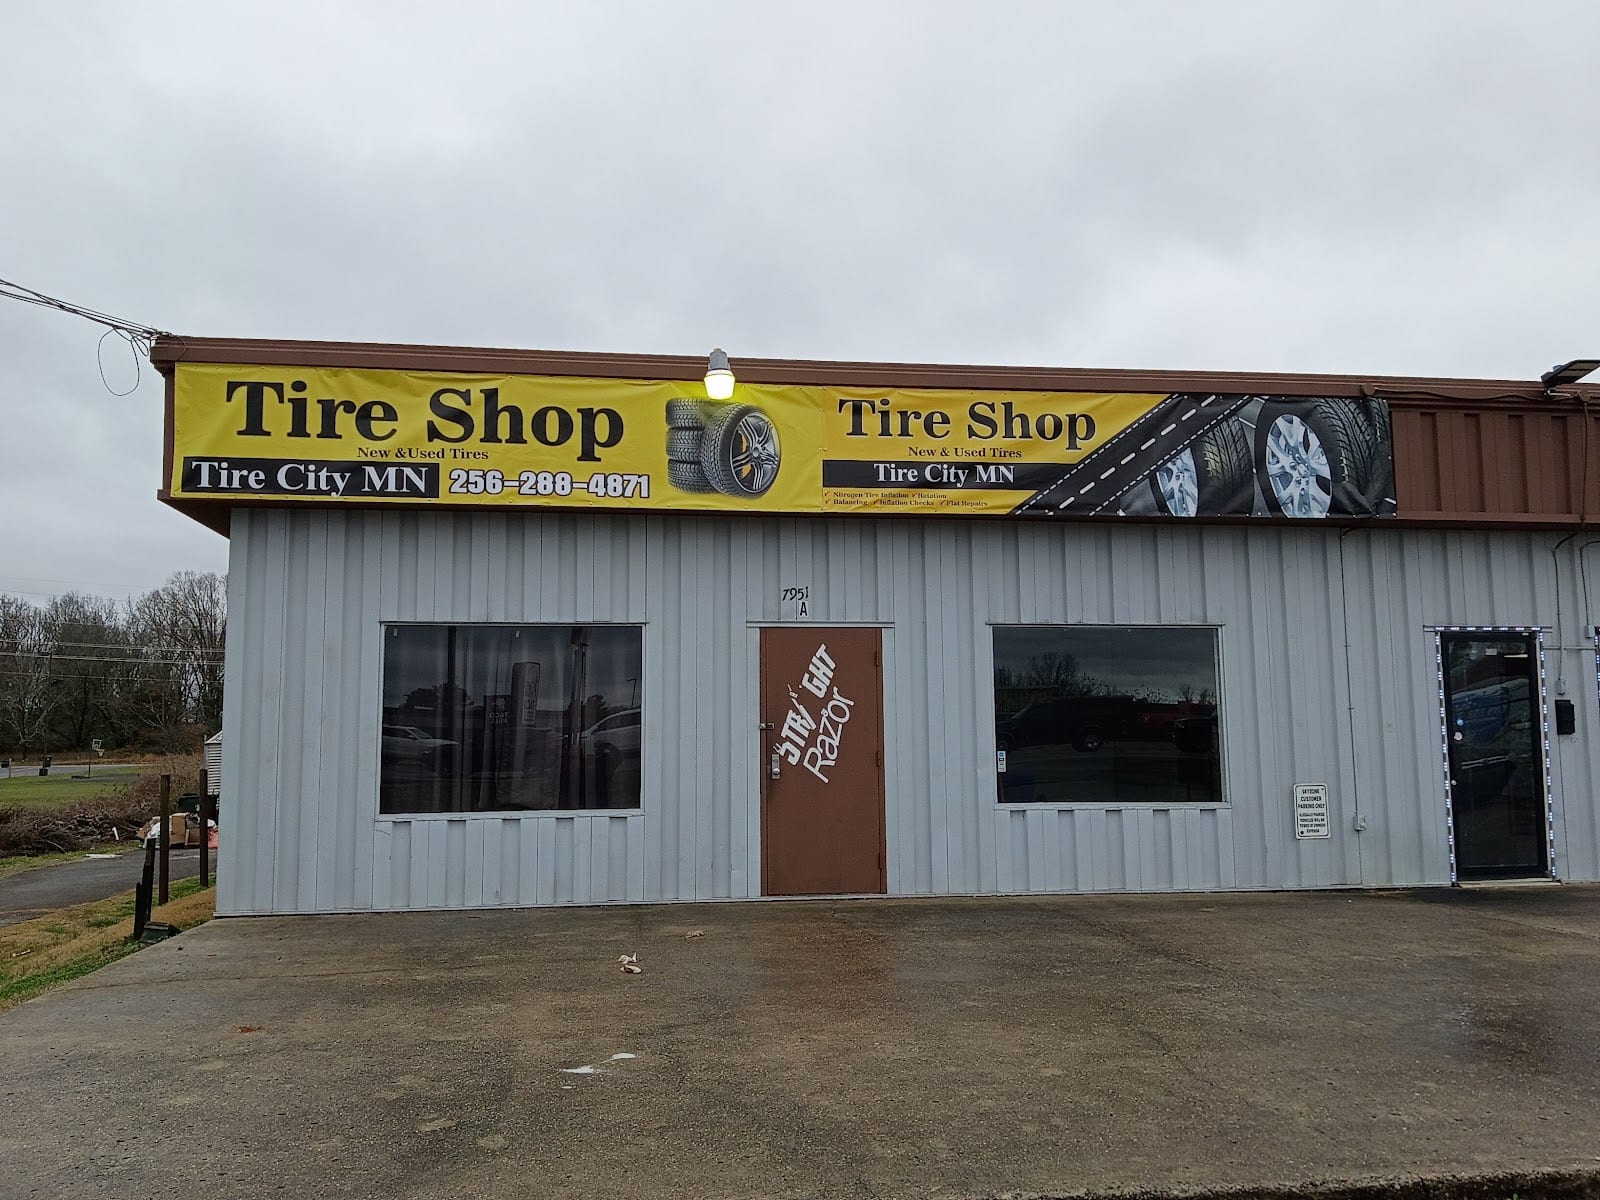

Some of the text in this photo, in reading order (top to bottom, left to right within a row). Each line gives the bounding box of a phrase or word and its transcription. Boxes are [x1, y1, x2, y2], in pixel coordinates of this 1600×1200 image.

[226, 380, 625, 462] Tire Shop
[838, 398, 1096, 450] Tire Shop
[357, 447, 391, 458] New
[450, 448, 489, 460] Tires
[908, 447, 1022, 459] New & Used Tires
[191, 460, 428, 497] Tire City MN
[449, 468, 650, 499] 256-288-4871
[873, 463, 1015, 488] Tire City MN
[782, 585, 809, 601] 7951
[799, 601, 808, 616] A
[803, 686, 855, 784] Razor
